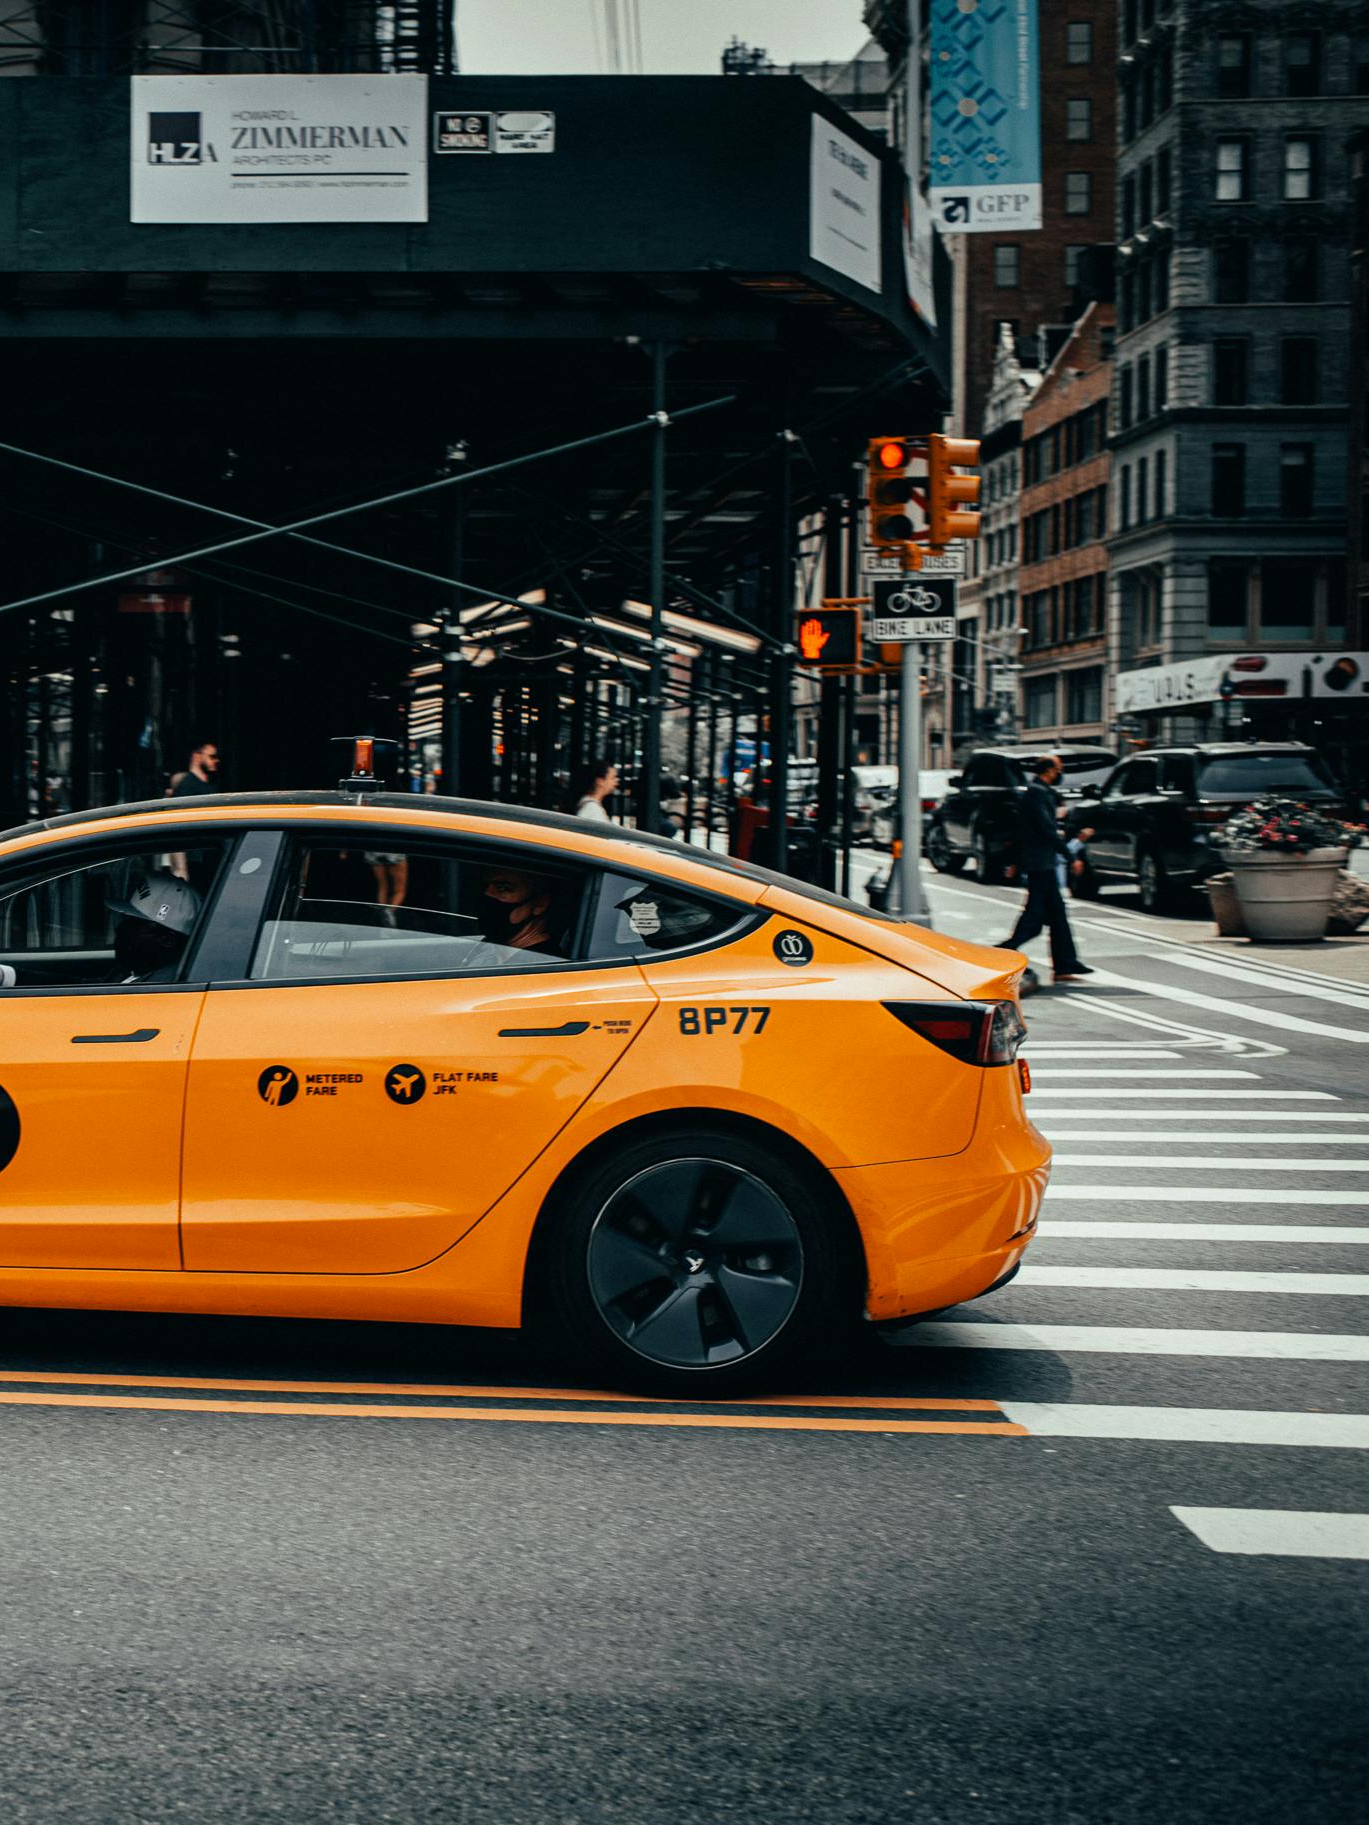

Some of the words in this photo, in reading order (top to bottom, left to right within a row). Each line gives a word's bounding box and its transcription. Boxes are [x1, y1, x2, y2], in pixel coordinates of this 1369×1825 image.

[231, 110, 287, 121] HOWARD
[231, 126, 410, 149] ZIMMERMAN
[232, 154, 311, 166] ARCHITECTS
[976, 193, 1030, 214] GFP
[876, 621, 908, 636] BIKE
[913, 620, 953, 635] LANE
[679, 1007, 771, 1035] 8P77
[306, 1074, 363, 1084] METERED
[433, 1072, 463, 1083] FLAT
[466, 1072, 498, 1082] FARE
[306, 1086, 337, 1096] FARE
[433, 1085, 457, 1095] JFK
